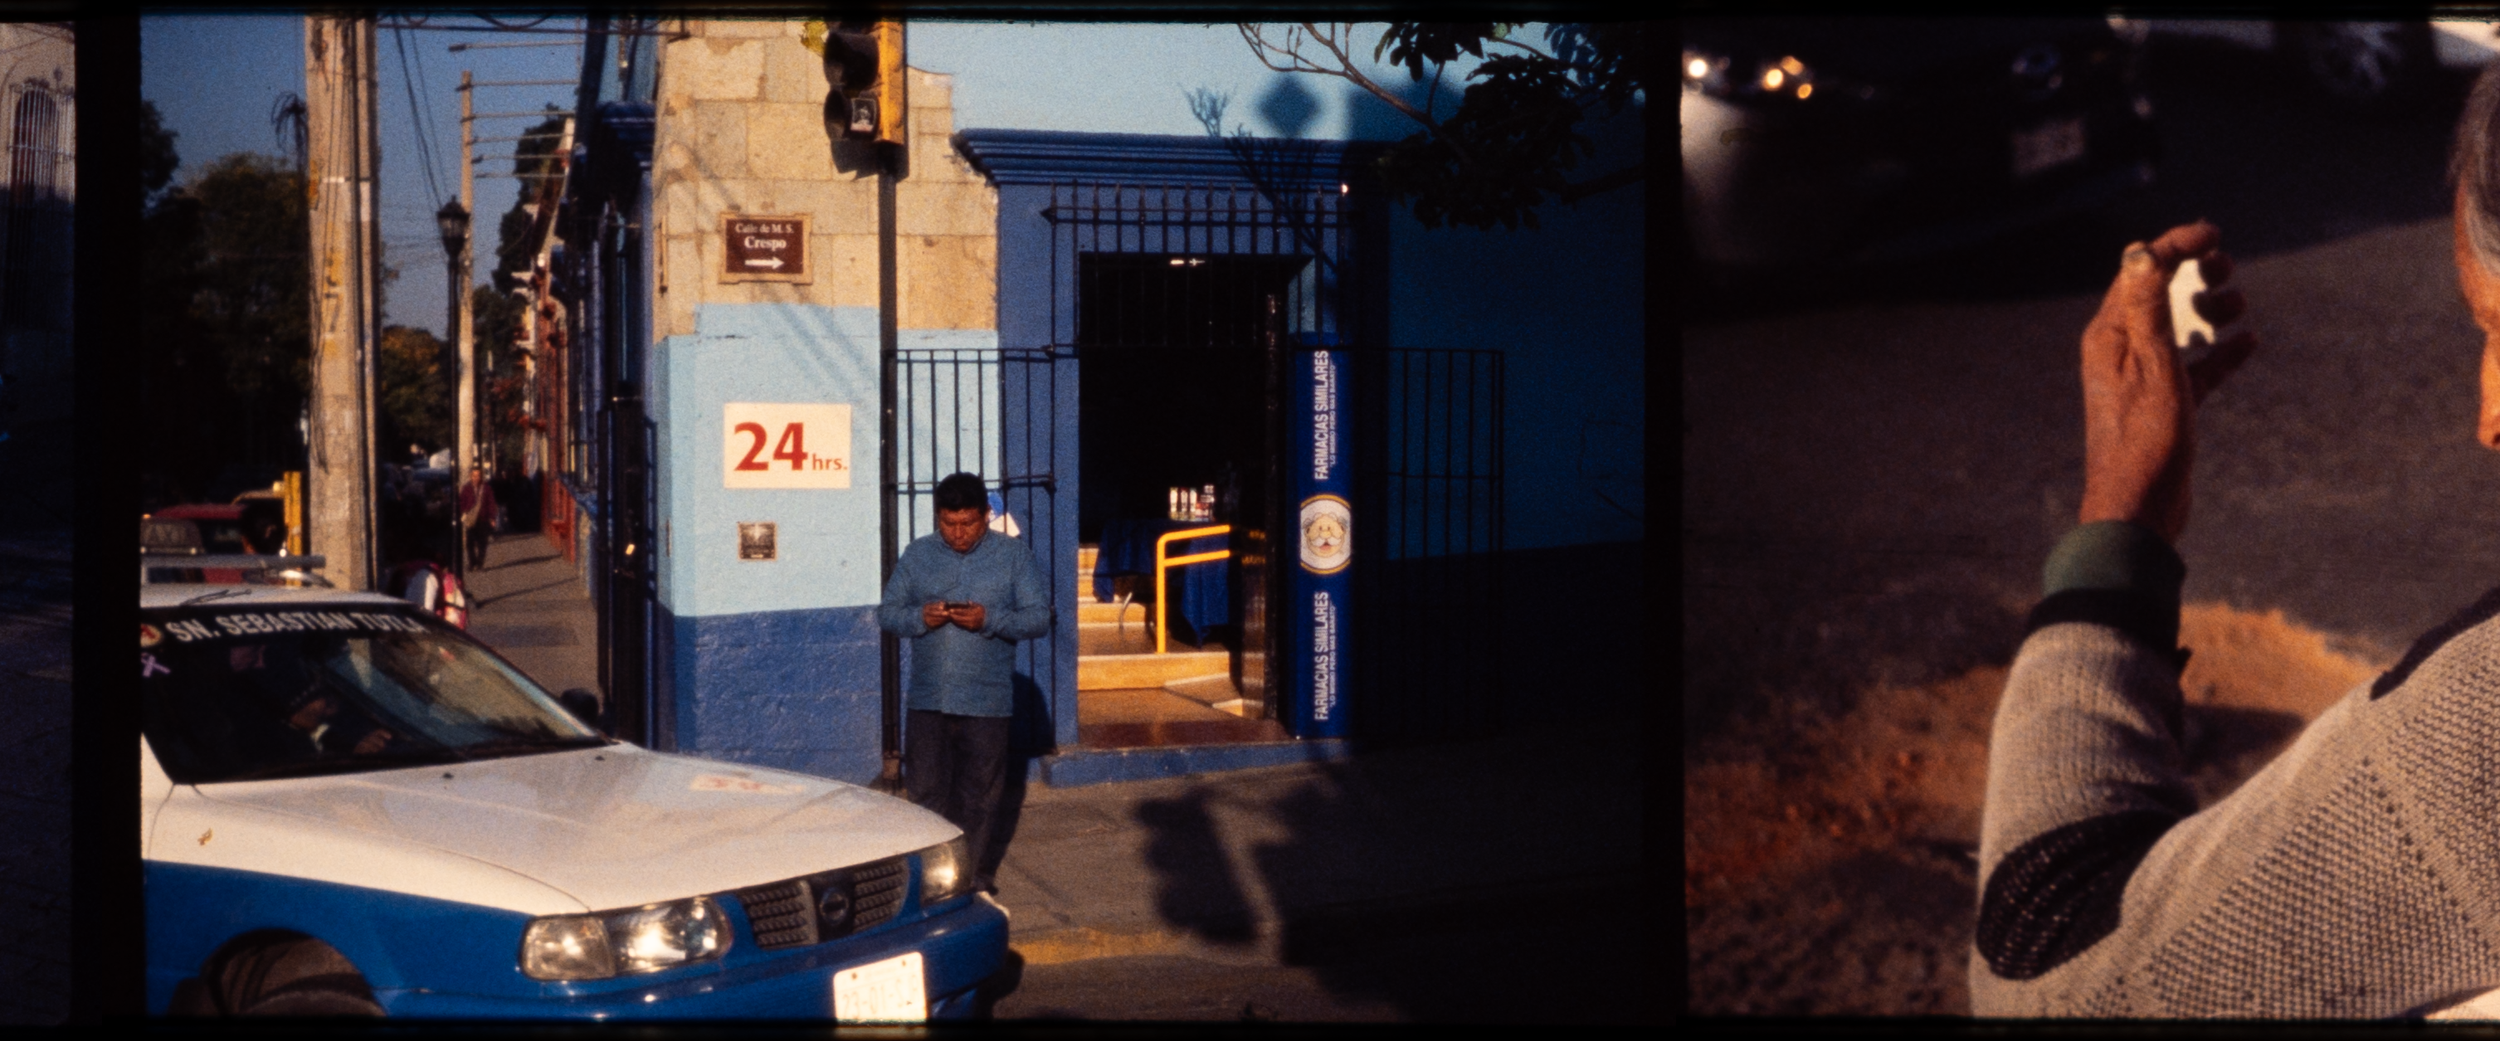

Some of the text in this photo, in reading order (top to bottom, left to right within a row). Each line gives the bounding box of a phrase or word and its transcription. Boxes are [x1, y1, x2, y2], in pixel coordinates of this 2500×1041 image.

[735, 223, 758, 233] Calle
[759, 223, 770, 233] de
[744, 235, 787, 252] Crespo
[1314, 350, 1329, 480] FARMACIAS SIMILARES
[733, 421, 848, 471] 24 hrs.
[165, 611, 431, 642] SN. SEBASTIAN TUTLA
[1314, 591, 1329, 720] FARMACIAS SIMILARES
